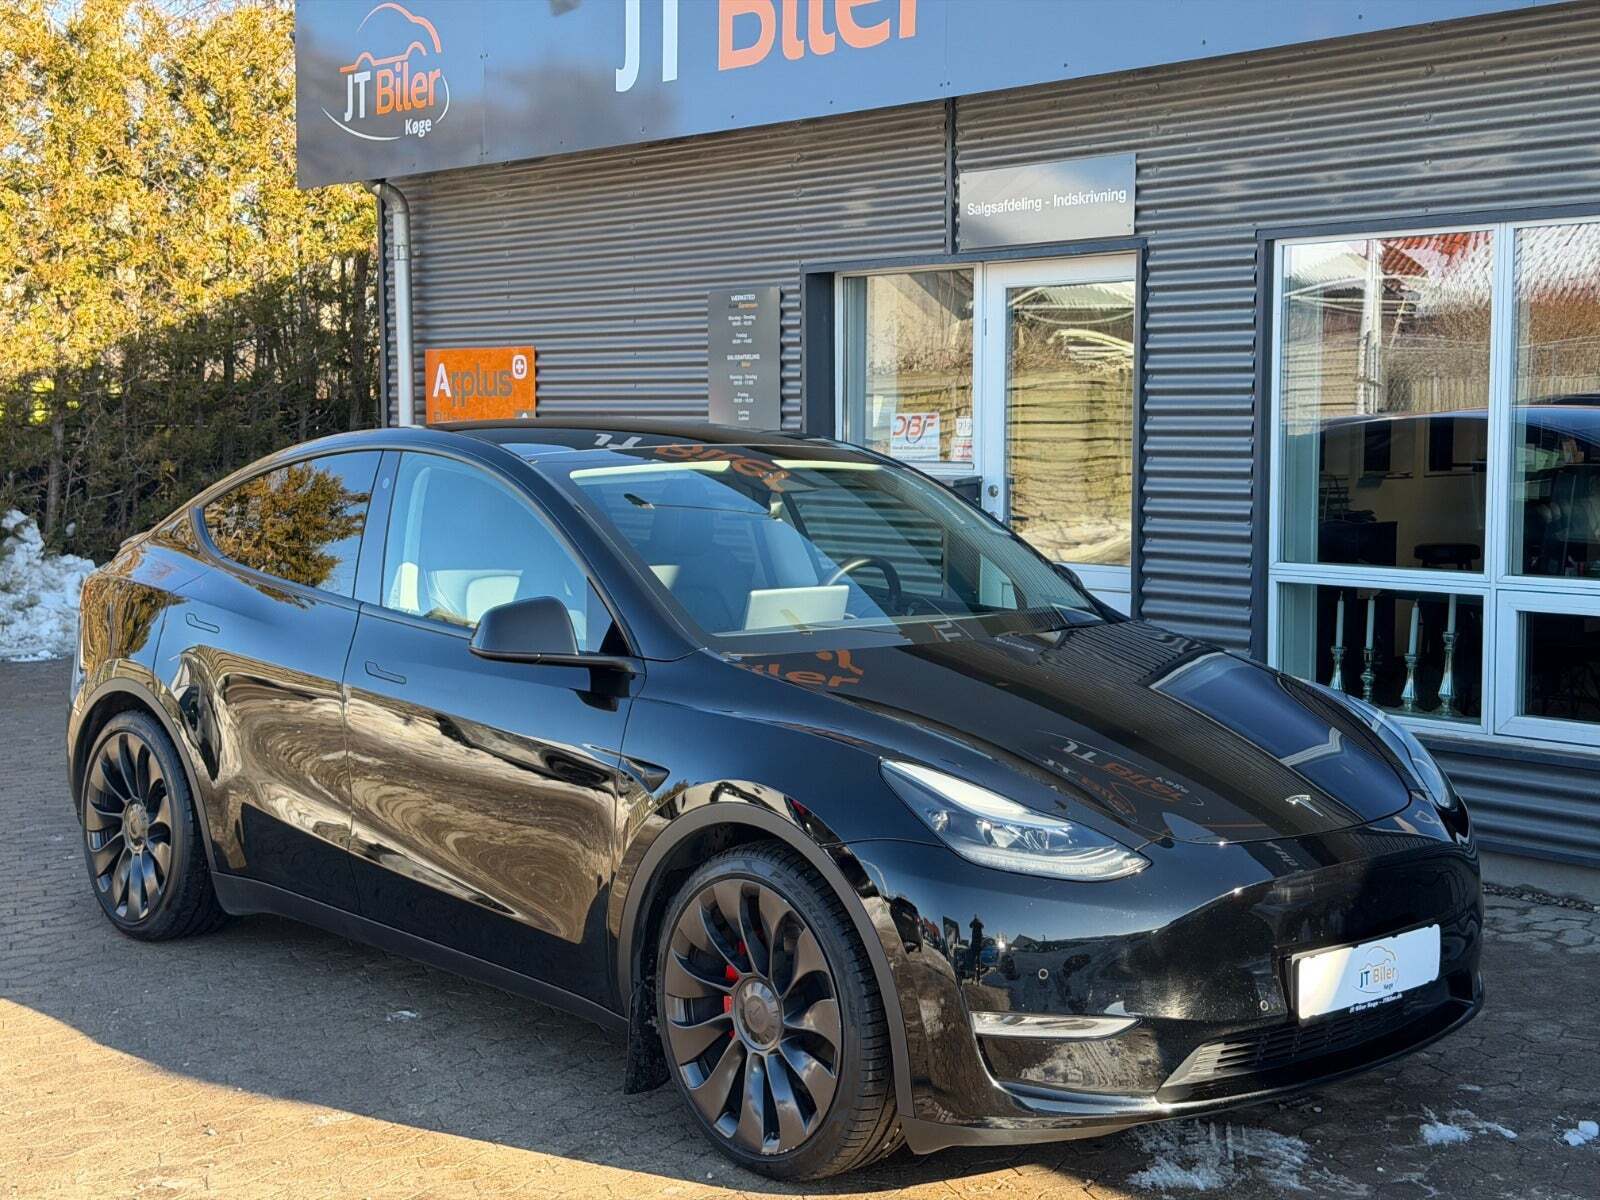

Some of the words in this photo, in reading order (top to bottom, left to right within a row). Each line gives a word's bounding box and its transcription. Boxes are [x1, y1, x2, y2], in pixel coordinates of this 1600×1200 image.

[344, 71, 371, 122] JT
[376, 62, 441, 115] Biler
[405, 119, 432, 137] Køge
[967, 198, 1042, 217] Salgsafdeling
[1053, 189, 1127, 208] Indskrivning
[1360, 970, 1370, 988] JT
[1373, 965, 1395, 983] Biler
